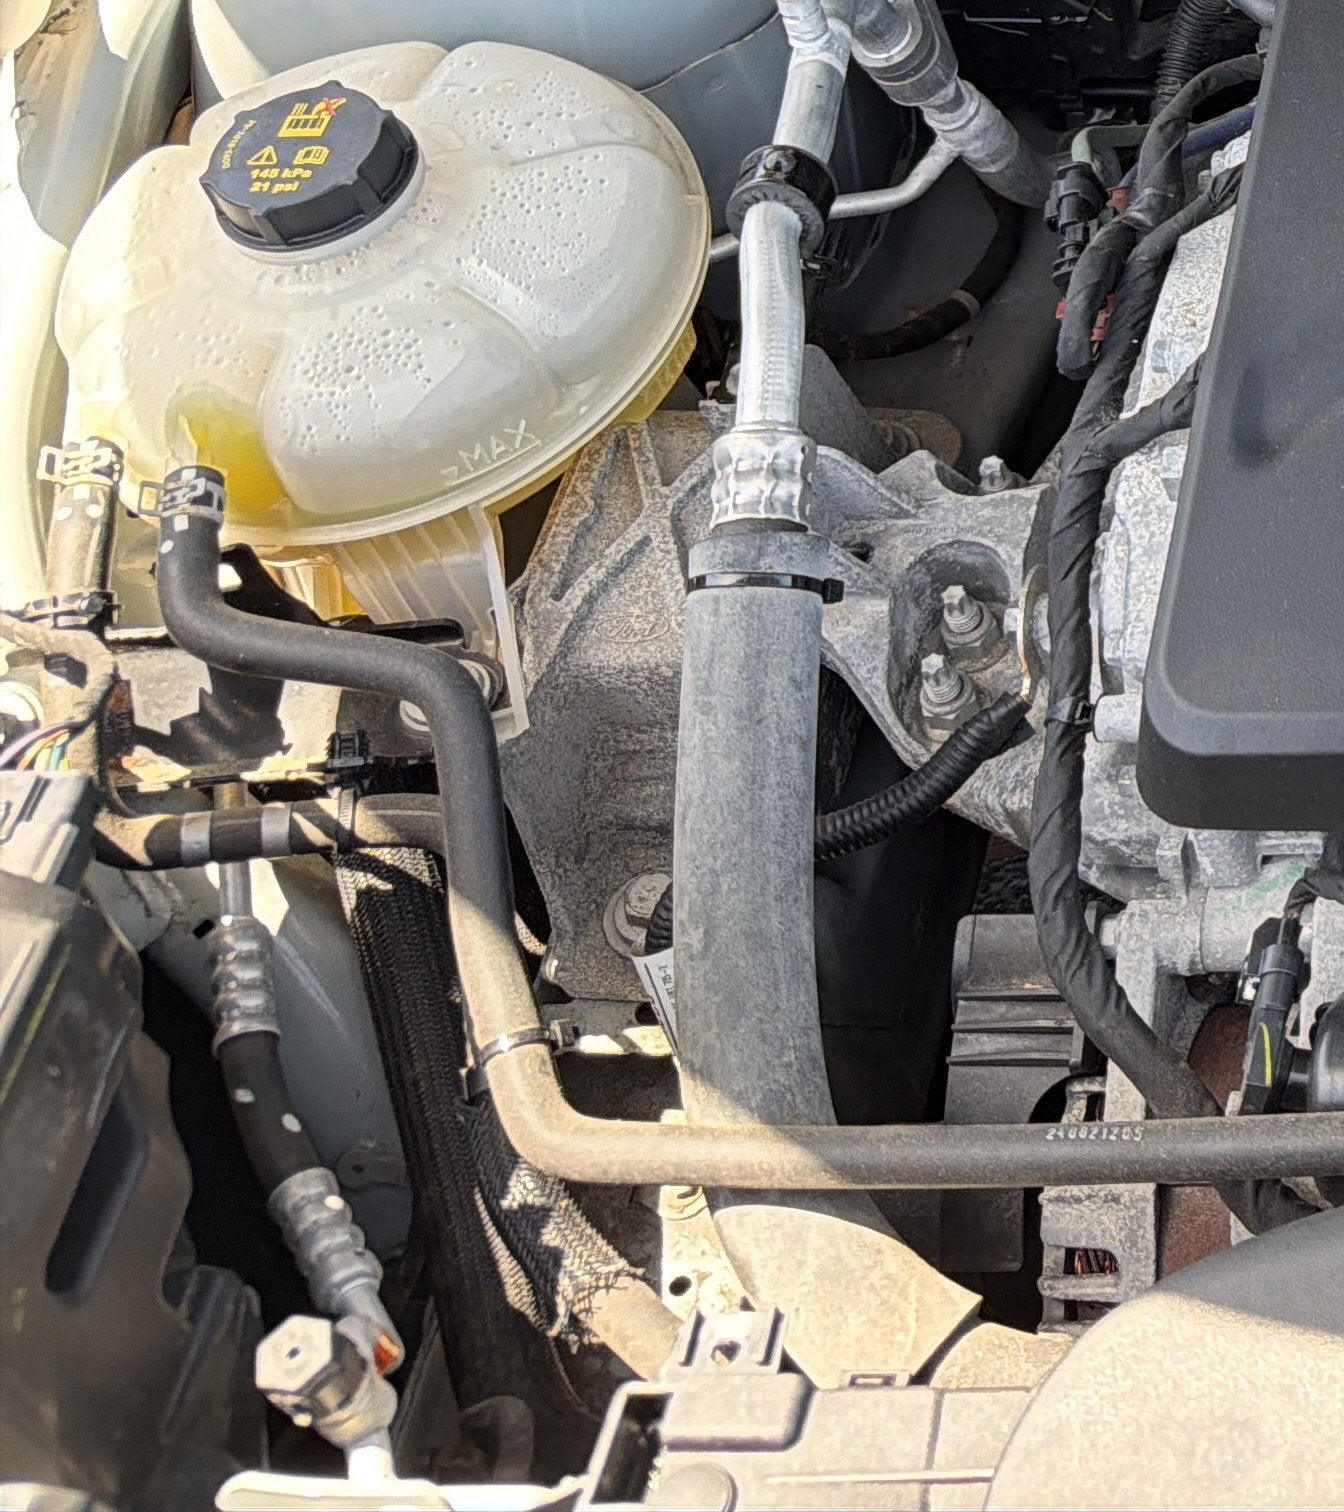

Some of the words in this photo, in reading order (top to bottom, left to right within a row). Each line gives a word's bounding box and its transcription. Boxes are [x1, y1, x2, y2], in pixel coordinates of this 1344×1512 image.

[251, 168, 279, 179] 145
[282, 168, 313, 179] kPa
[250, 181, 272, 192] 21
[272, 181, 299, 194] psi
[458, 419, 537, 472] MAX
